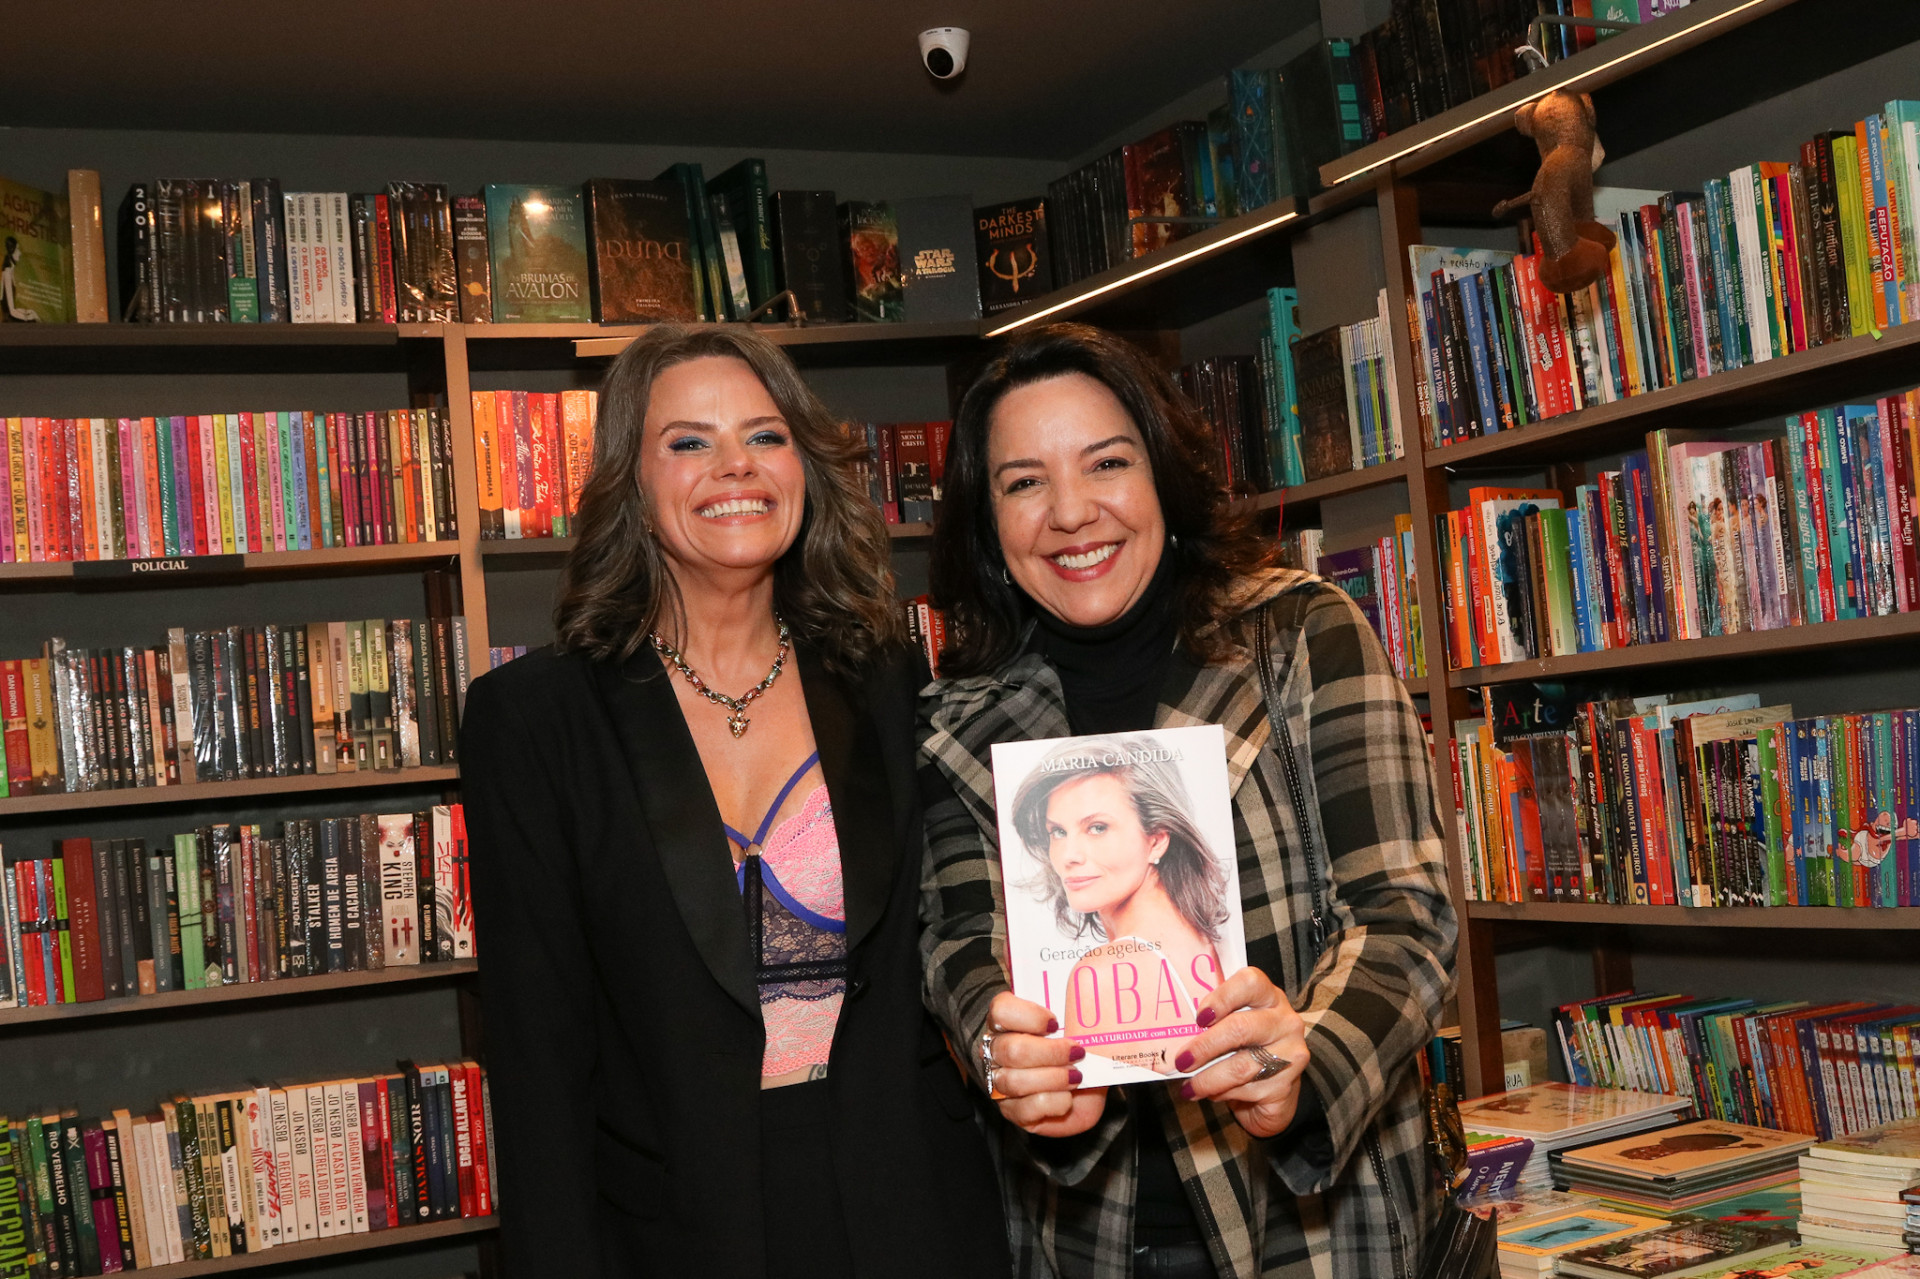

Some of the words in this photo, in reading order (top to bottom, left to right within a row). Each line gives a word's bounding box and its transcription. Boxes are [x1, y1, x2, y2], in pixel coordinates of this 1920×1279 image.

[1860, 147, 1872, 174] GENTE
[1864, 177, 1875, 212] ANSIOSA
[979, 209, 1043, 230] DARKEST
[1002, 206, 1017, 214] THE
[1871, 137, 1881, 181] CROUCHER
[1877, 209, 1892, 281] REPUTAÇÃO
[989, 223, 1033, 239] MINDS
[915, 255, 954, 268] WARS
[918, 249, 952, 259] STAR
[1809, 184, 1821, 230] FILHOS
[1821, 297, 1833, 332] OSSO
[521, 272, 566, 284] BRUMAS
[1873, 255, 1884, 294] BACKMAN
[506, 283, 579, 298] AVALON
[1526, 322, 1538, 364] ESPELHOS
[1431, 348, 1440, 368] EMILY
[1434, 370, 1442, 380] EM
[1436, 382, 1444, 403] PARIS
[1806, 421, 1814, 440] JEAN
[1836, 416, 1845, 439] JEAN
[533, 442, 546, 470] Contos
[1808, 442, 1817, 469] EMIKO
[1839, 441, 1848, 464] EMIKO
[535, 471, 542, 480] de
[1796, 489, 1807, 509] NÓS
[1615, 499, 1628, 547] BLACKOUT
[1648, 524, 1656, 545] MUDA
[1800, 512, 1811, 545] ENTRE
[132, 560, 189, 572] POLICIAL
[1650, 548, 1658, 569] TUDO
[1803, 547, 1814, 570] FICA
[419, 624, 427, 655] DEIXADA
[456, 629, 464, 658] GAROTA
[421, 658, 429, 677] PARA
[458, 660, 465, 671] DO
[7, 674, 16, 689] DAN
[32, 674, 40, 689] DAN
[423, 679, 431, 697] TRÁS
[9, 690, 18, 716] BROWN
[33, 689, 42, 715] BROWN
[1504, 697, 1559, 729] Arte
[1040, 757, 1099, 773] MARIA
[1103, 748, 1184, 767] CANDIDA
[1484, 763, 1493, 791] DÚVIDA
[1620, 753, 1632, 797] ENQUANTO
[1487, 793, 1495, 815] CRUEL
[1589, 780, 1597, 805] diário
[1591, 806, 1602, 839] perdido
[1626, 798, 1637, 832] HOUVER
[1644, 818, 1652, 838] EMILY
[99, 852, 107, 868] JOHN
[116, 850, 124, 866] JOHN
[133, 848, 141, 864] JOHN
[1630, 833, 1642, 875] LIMOEIROS
[325, 857, 338, 885] AREIA
[1463, 863, 1469, 872] DE
[100, 869, 109, 898] GRISHAM
[383, 862, 402, 900] KING
[402, 861, 414, 899] STEPHEN
[291, 872, 301, 926] POLTERGEIST
[307, 884, 321, 928] STALKER
[327, 890, 339, 902] DE
[82, 901, 90, 923] MAIS
[329, 904, 341, 939] HOMEM
[1040, 945, 1103, 962] Geração
[1107, 937, 1162, 959] ageless
[1042, 953, 1216, 1032] LOBAS
[1091, 1030, 1149, 1044] MATURIDADE
[1151, 1030, 1166, 1038] com
[1112, 1053, 1137, 1062] Literare
[1139, 1051, 1159, 1059] Books
[453, 1080, 465, 1099] POE
[1506, 1073, 1524, 1091] RUA
[274, 1101, 285, 1112] JO
[310, 1095, 321, 1106] JO
[328, 1095, 339, 1106] JO
[344, 1091, 354, 1101] JO
[411, 1104, 423, 1144] NOIR
[455, 1100, 470, 1136] ALLAN
[48, 1131, 58, 1149] RIO
[348, 1132, 360, 1171] GARGANTA
[292, 1111, 304, 1123] JO
[299, 1180, 310, 1199] SEDE
[315, 1144, 326, 1178] ESTRELA
[333, 1151, 344, 1175] CASA
[459, 1138, 472, 1167] EDGAR
[51, 1151, 67, 1205] VERMELHO
[279, 1161, 293, 1206] REDENTOR
[318, 1180, 328, 1190] DO
[334, 1177, 345, 1189] DA
[416, 1145, 428, 1202] DAMAS
[319, 1192, 331, 1216] DIABO
[336, 1192, 347, 1211] DOR
[350, 1172, 364, 1213] VERMELHA
[64, 1231, 74, 1254] LLOYD
